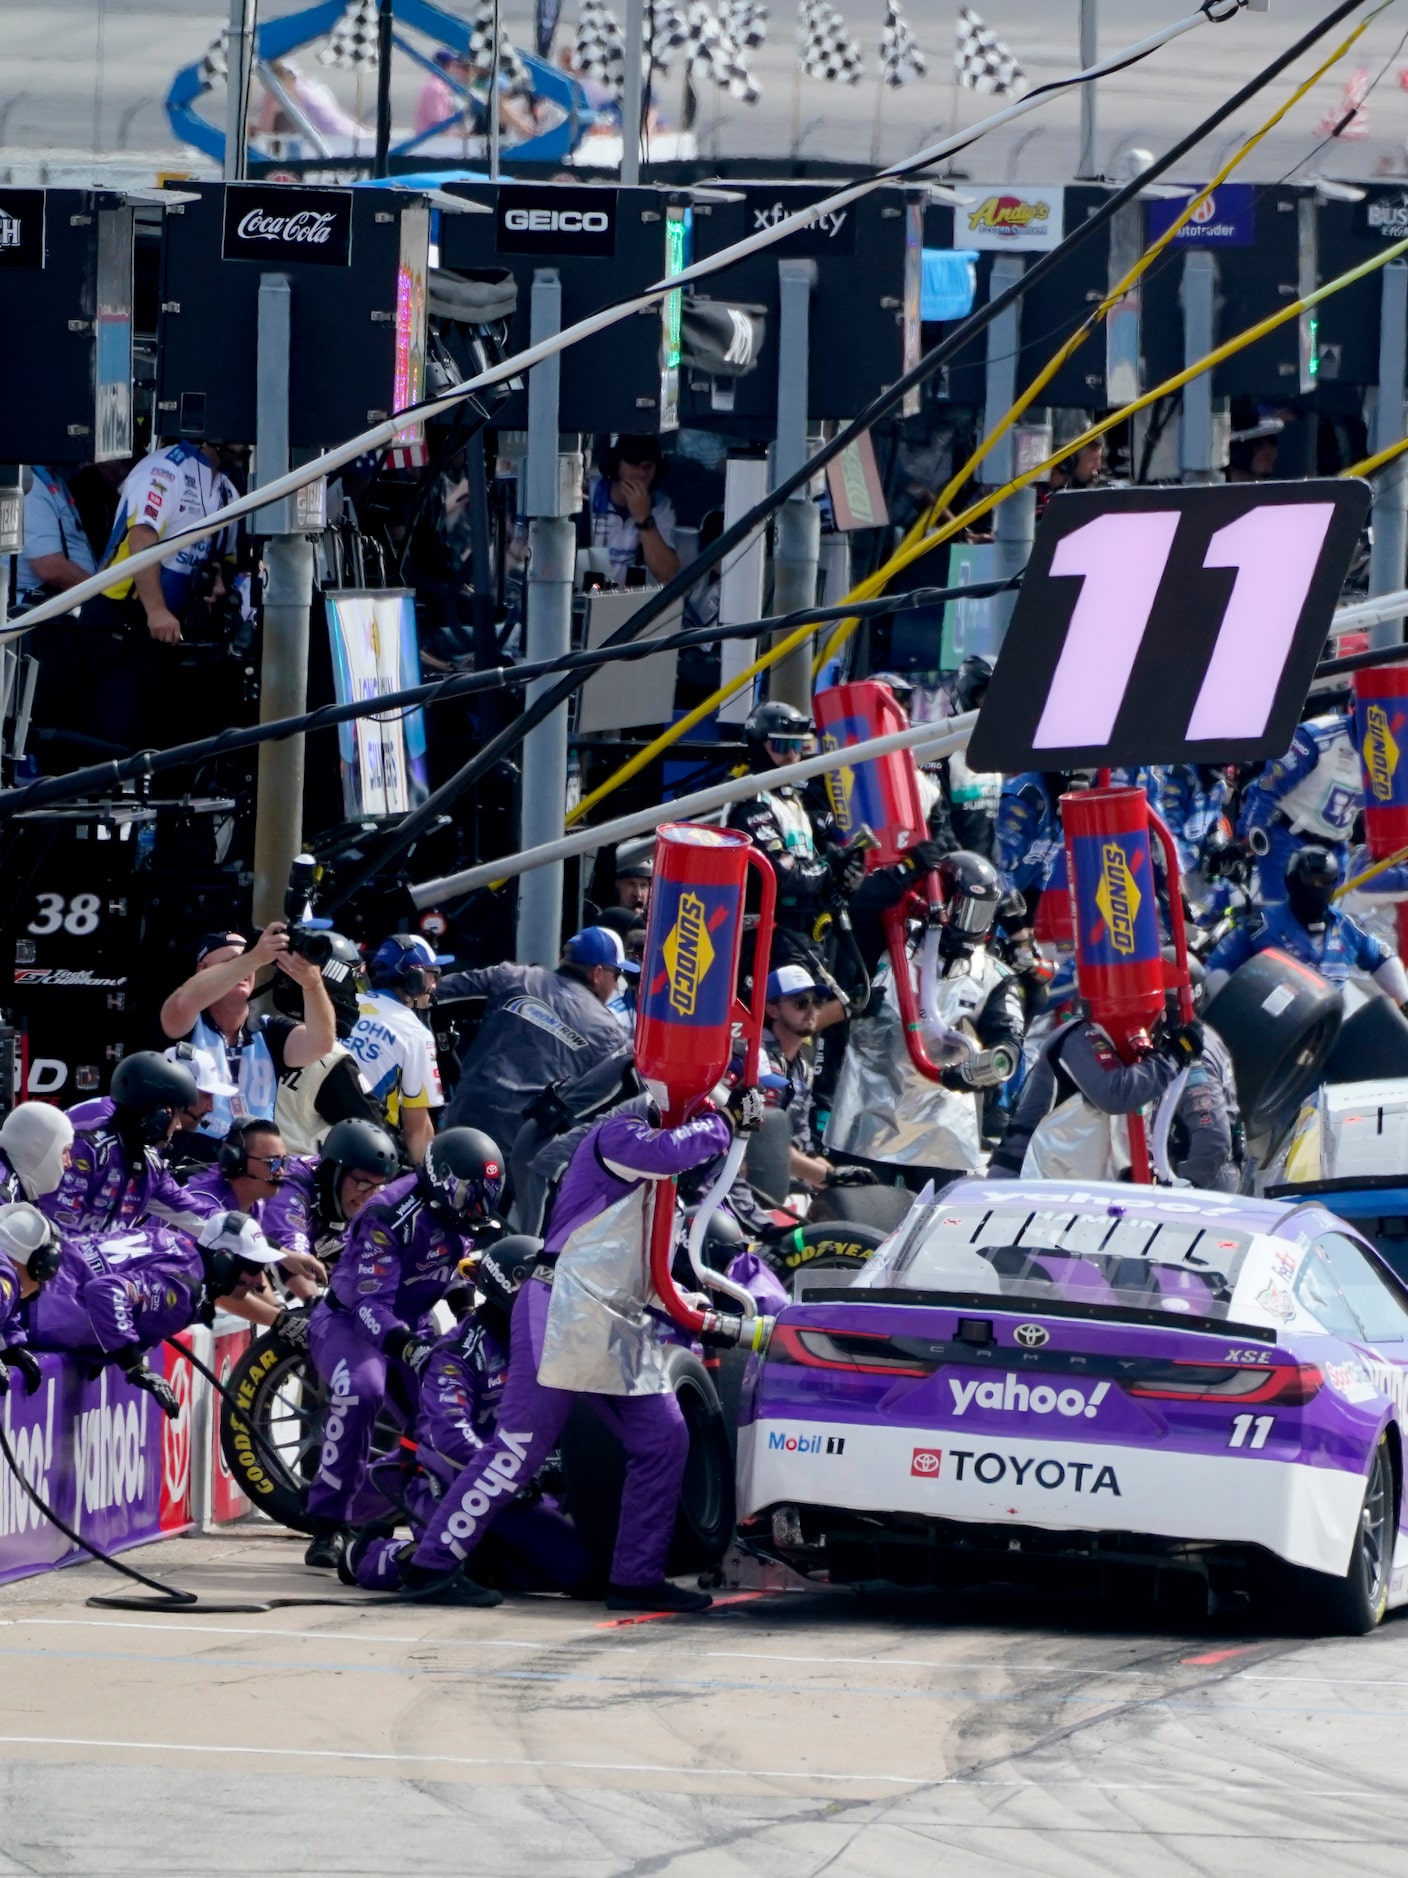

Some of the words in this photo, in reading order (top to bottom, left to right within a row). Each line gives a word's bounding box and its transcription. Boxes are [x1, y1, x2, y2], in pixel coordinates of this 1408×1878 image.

[237, 208, 338, 244] Coca-Cola
[504, 209, 609, 233] GEICO
[969, 195, 1049, 230] Andy's
[1175, 225, 1235, 238] utotrader
[1031, 502, 1337, 750] 11
[1368, 709, 1392, 799] SUNOCO
[27, 892, 101, 935] 38
[1104, 845, 1134, 952] SUNOCO
[672, 898, 704, 1011] SUNOCO
[356, 1019, 396, 1046] OHN
[1224, 1348, 1273, 1366] XSE
[948, 1372, 1111, 1419] yahoo!
[317, 1357, 360, 1492] yahoo!
[768, 1431, 822, 1455] Mobil
[825, 1436, 846, 1456] 1
[1225, 1412, 1277, 1450] 11
[73, 1356, 149, 1552] yahoo!
[948, 1449, 1123, 1498] TOYOTA
[439, 1427, 534, 1562] yahoo!
